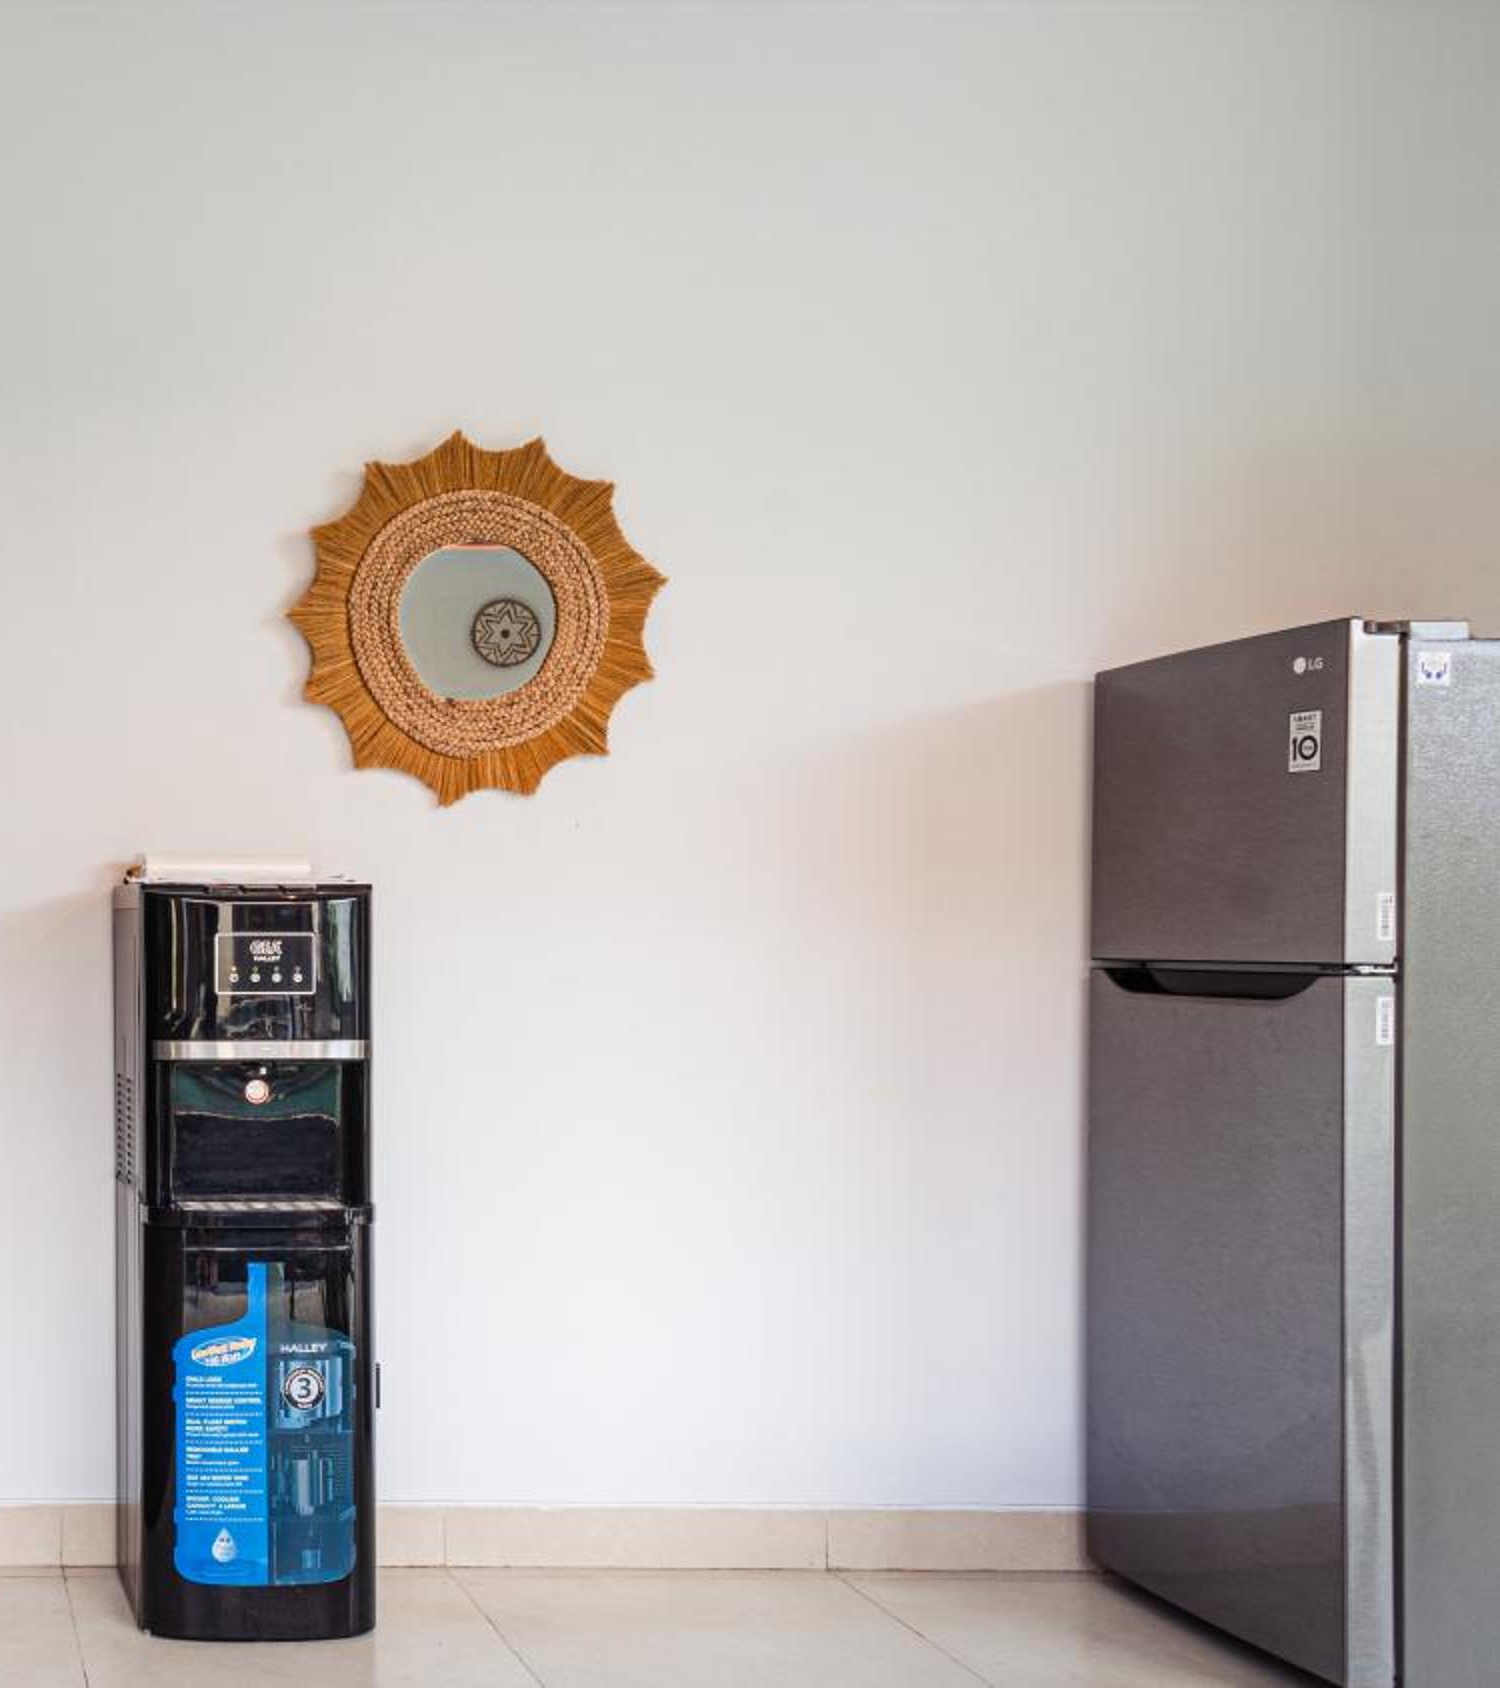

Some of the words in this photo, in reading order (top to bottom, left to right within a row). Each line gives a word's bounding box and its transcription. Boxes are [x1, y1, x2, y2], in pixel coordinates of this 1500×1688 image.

[1308, 657, 1323, 671] LG
[1292, 735, 1318, 761] 10
[280, 1343, 327, 1353] HALLEY
[297, 1377, 311, 1399] 3
